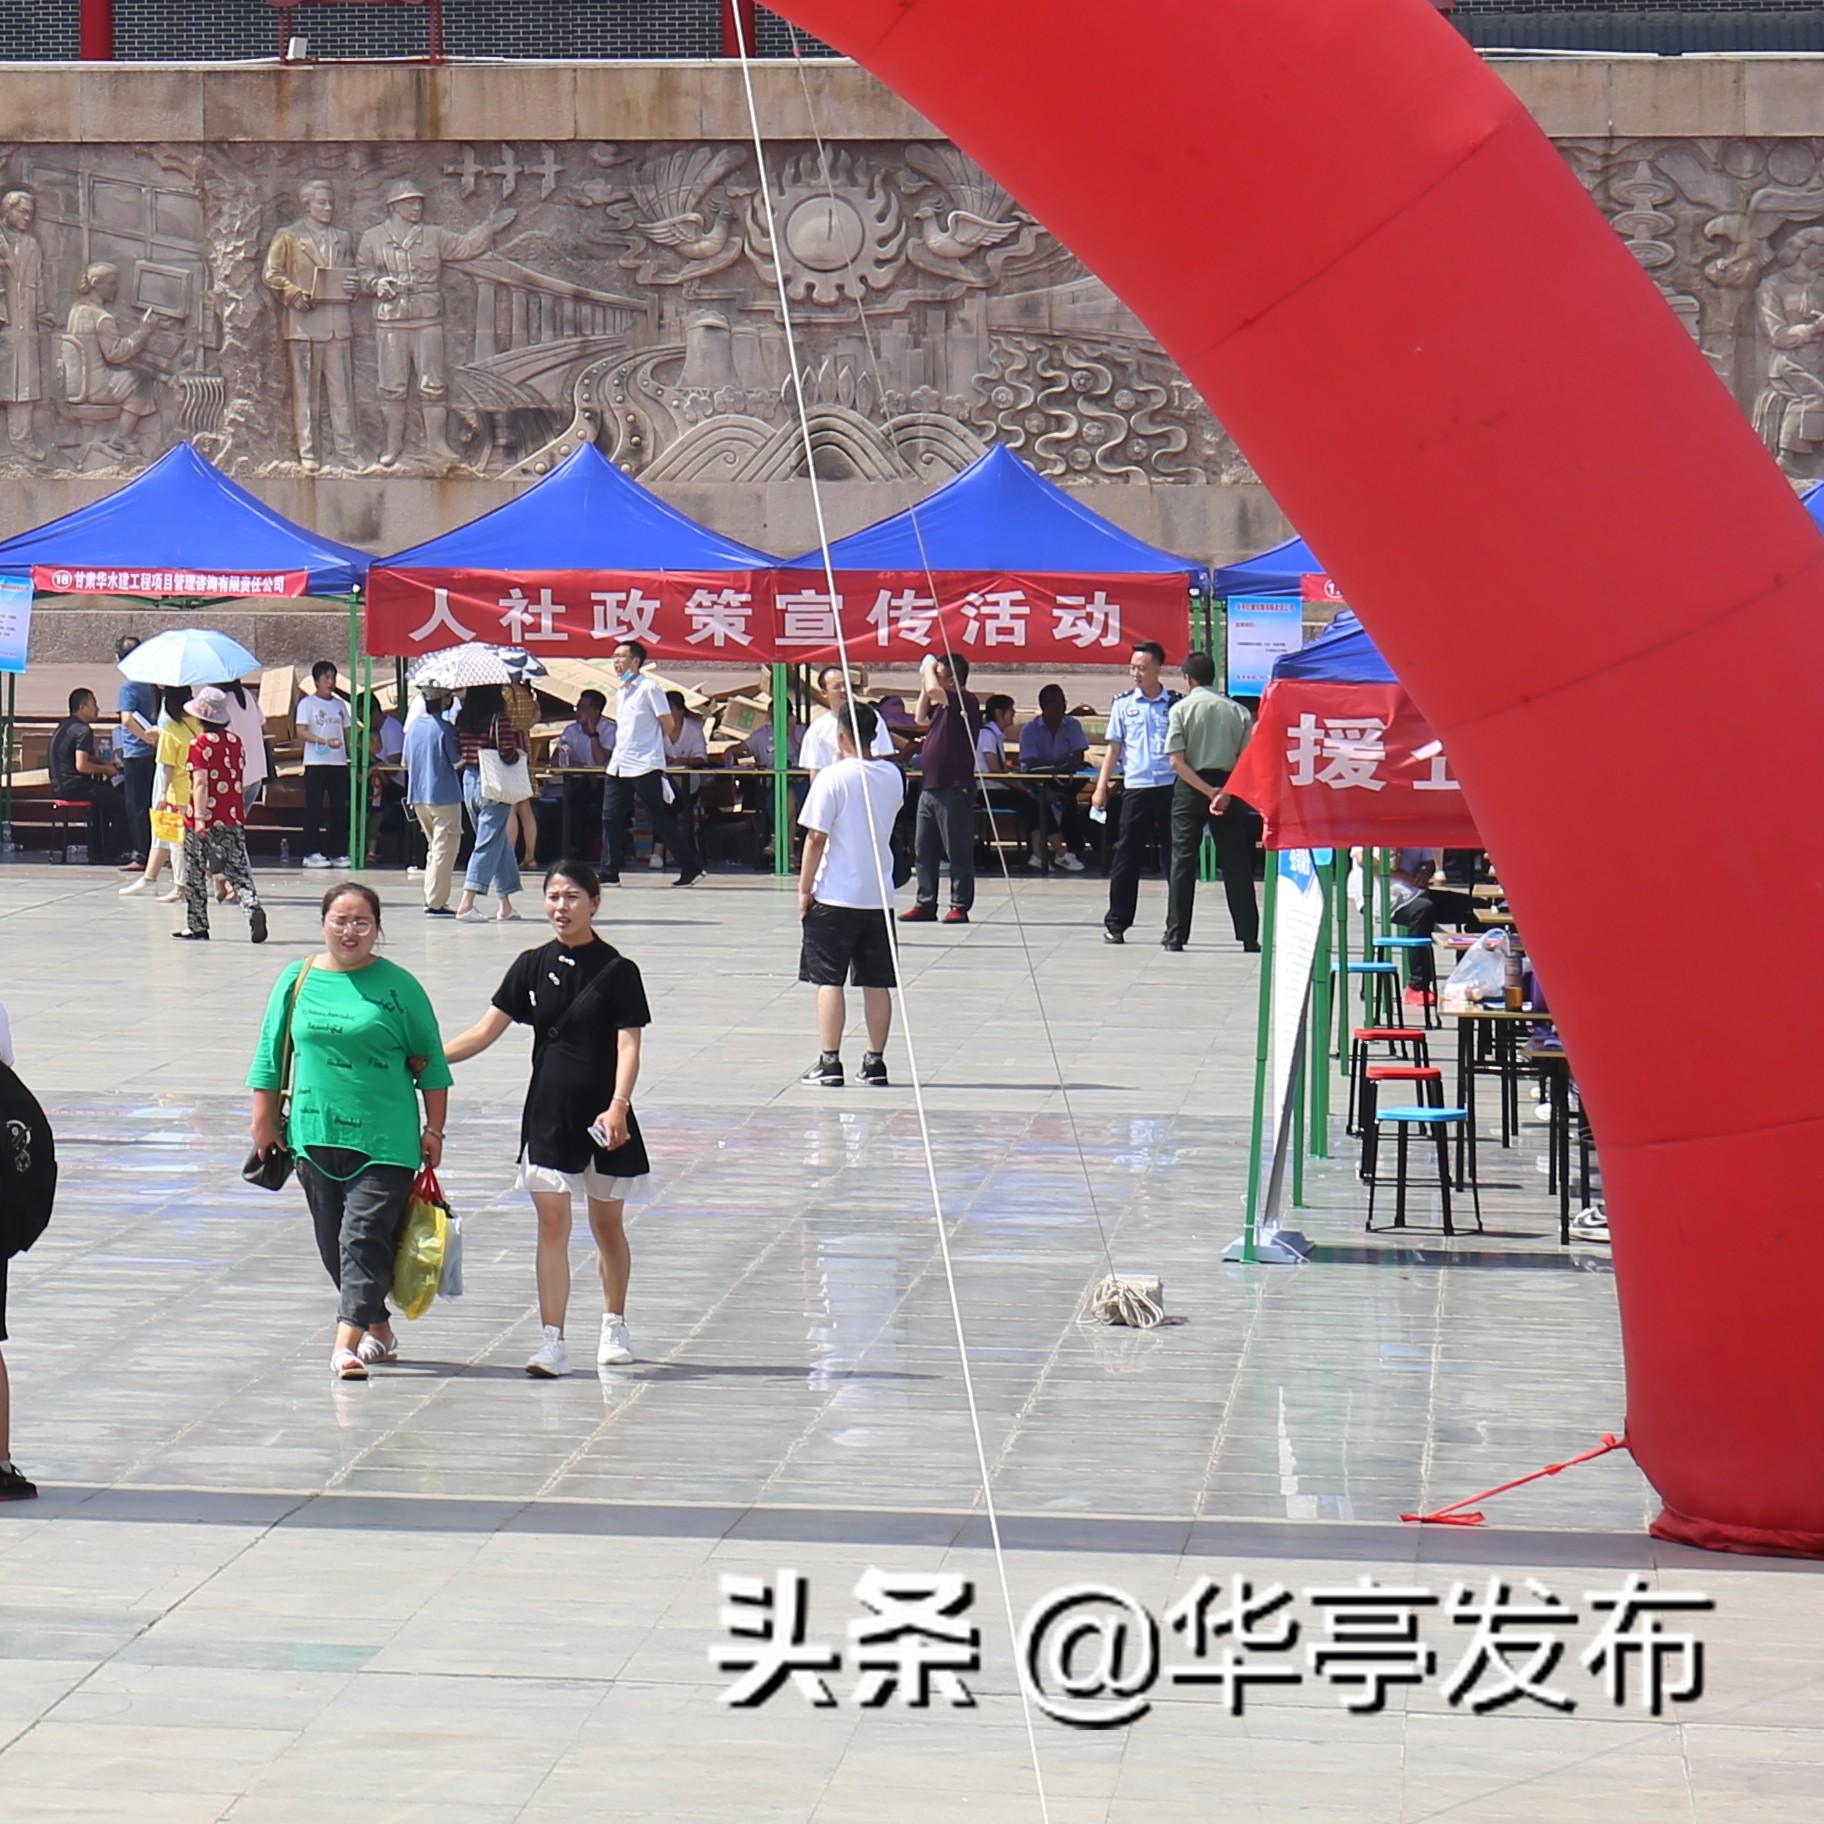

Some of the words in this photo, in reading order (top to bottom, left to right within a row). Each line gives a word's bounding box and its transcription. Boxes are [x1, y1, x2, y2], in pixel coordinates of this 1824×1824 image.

[407, 587, 1122, 648] 人社政策宣传活动
